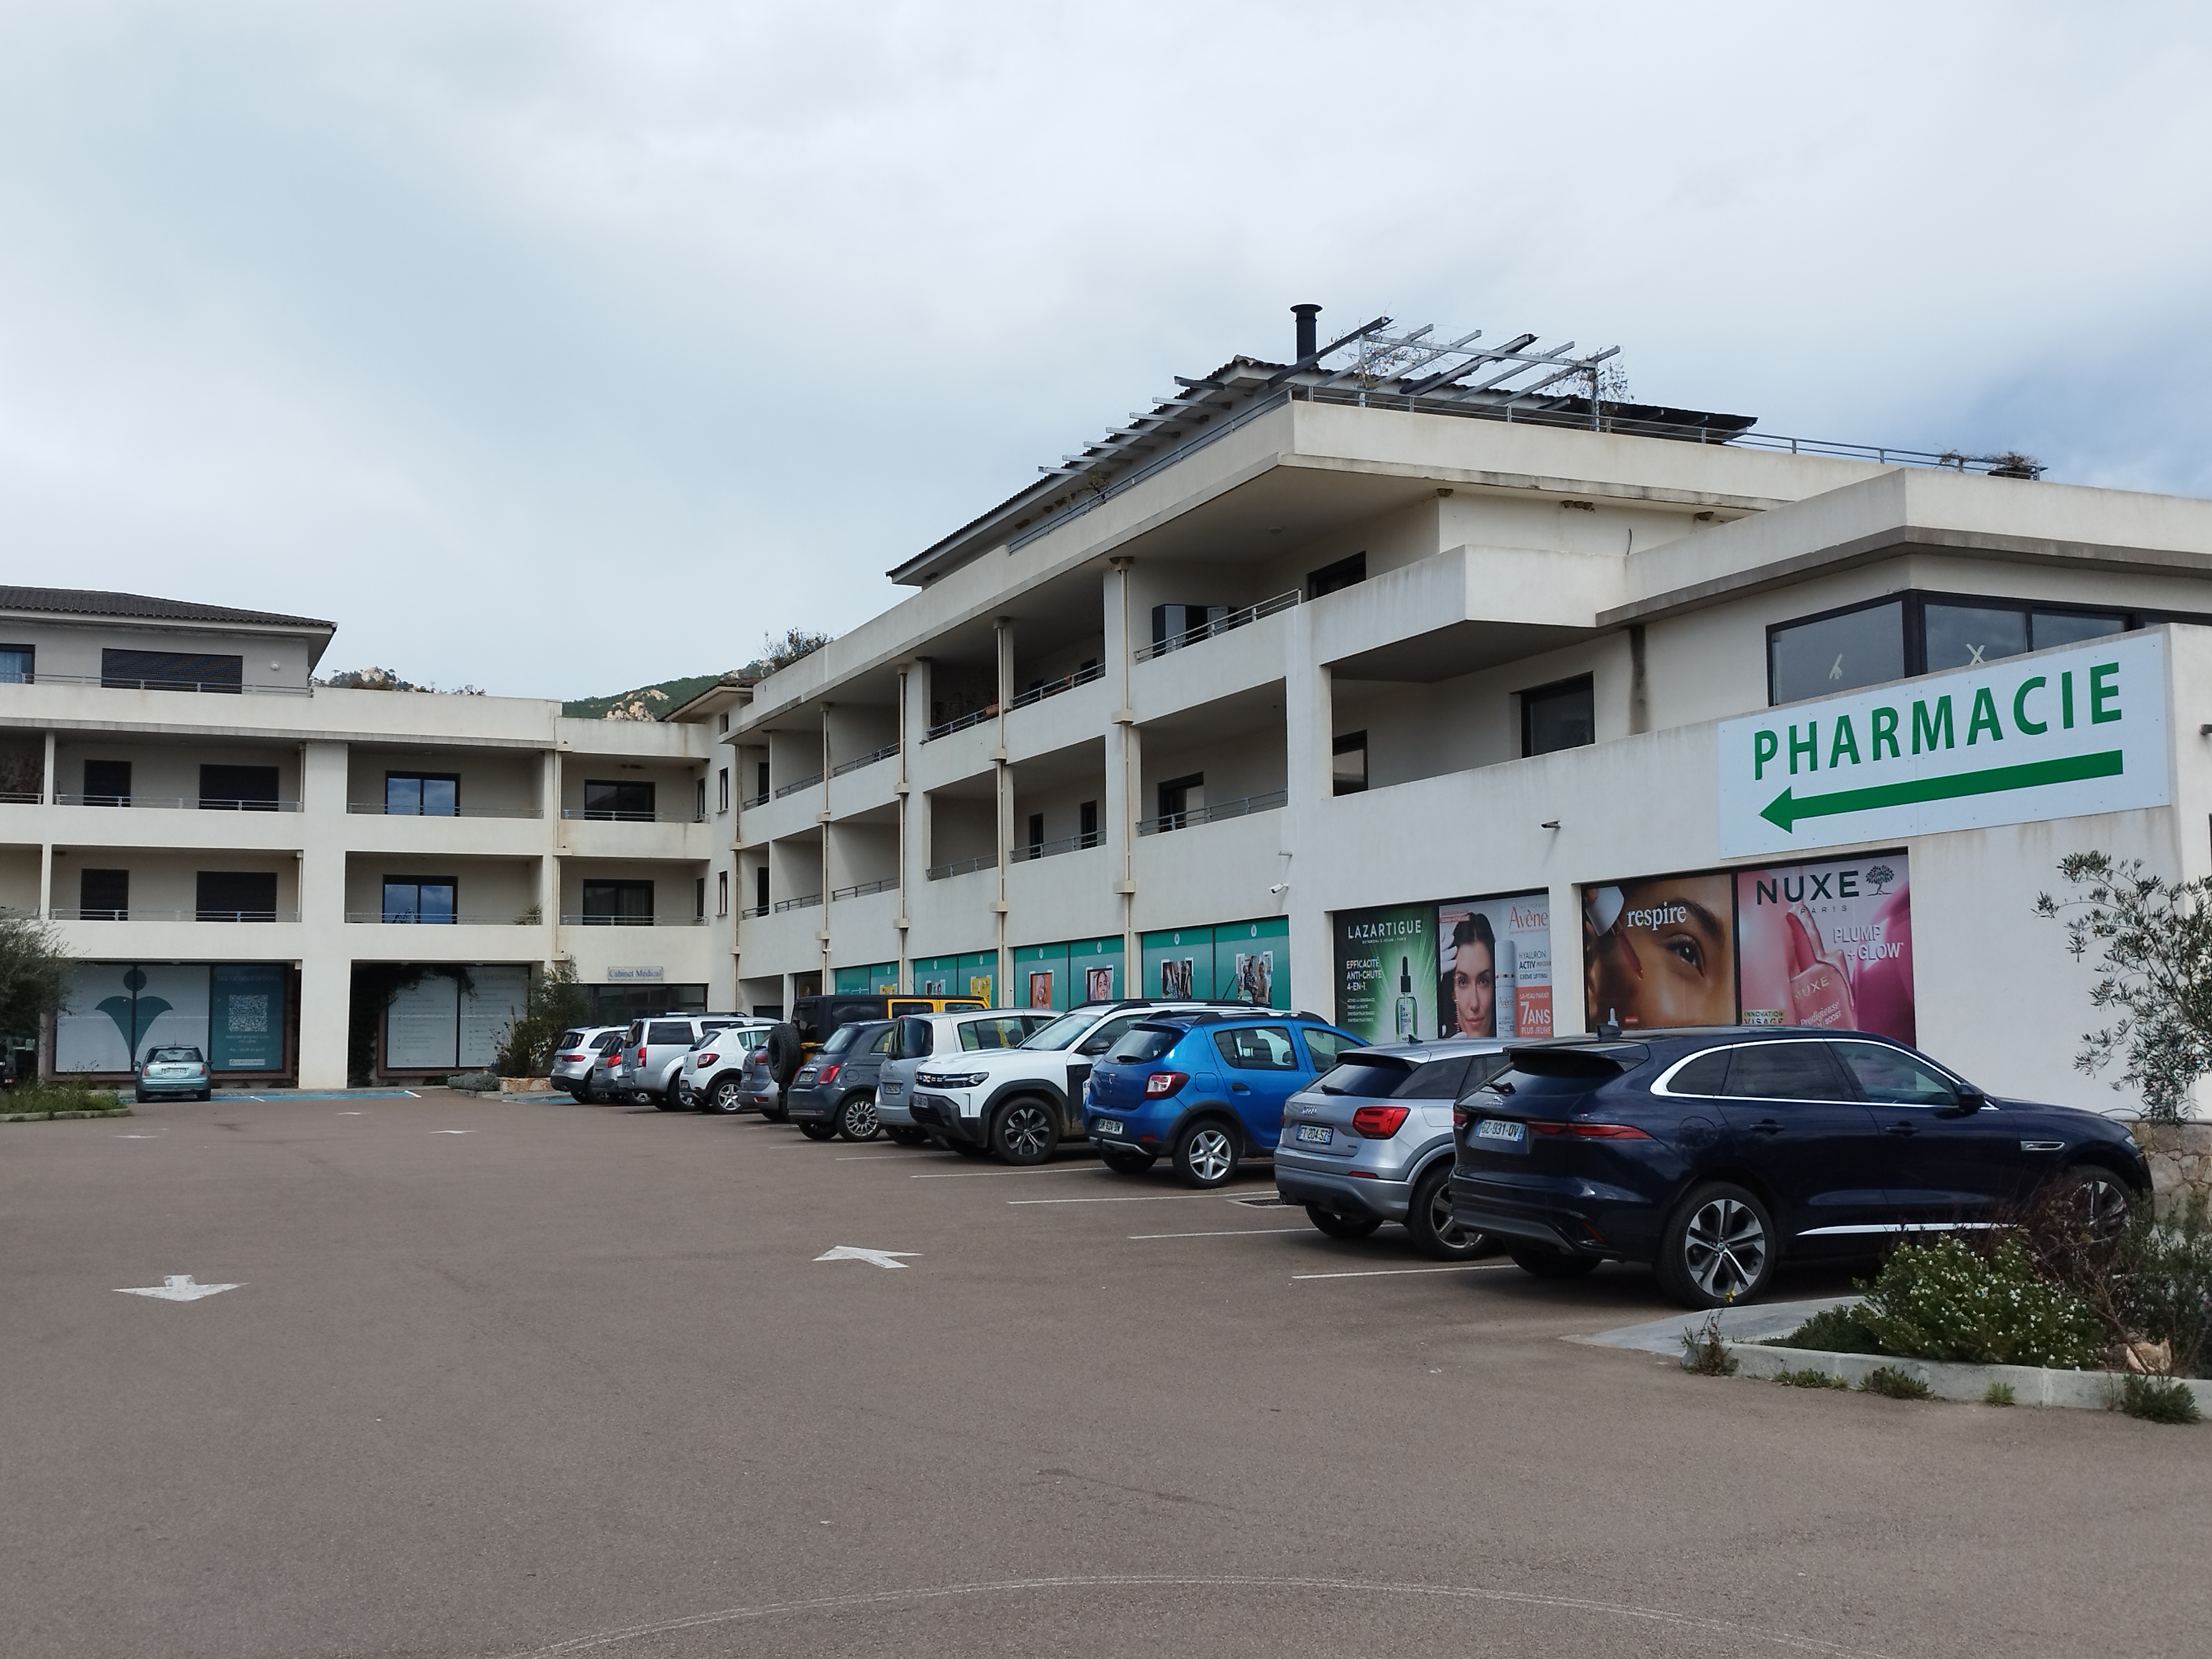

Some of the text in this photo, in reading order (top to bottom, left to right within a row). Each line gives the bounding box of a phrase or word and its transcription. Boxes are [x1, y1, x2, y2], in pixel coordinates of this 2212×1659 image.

[1755, 661, 2122, 780] PHARMACIE
[1756, 870, 1859, 905] NUXE
[1509, 906, 1548, 928] Avène
[1626, 901, 1687, 931] respire
[1800, 905, 1848, 914] PARIS
[1348, 919, 1422, 939] LAZARTIGUE
[1833, 925, 1881, 943] PLUMP
[1347, 969, 1382, 981] ANTI-CHUTE
[1519, 961, 1536, 969] ACTIV
